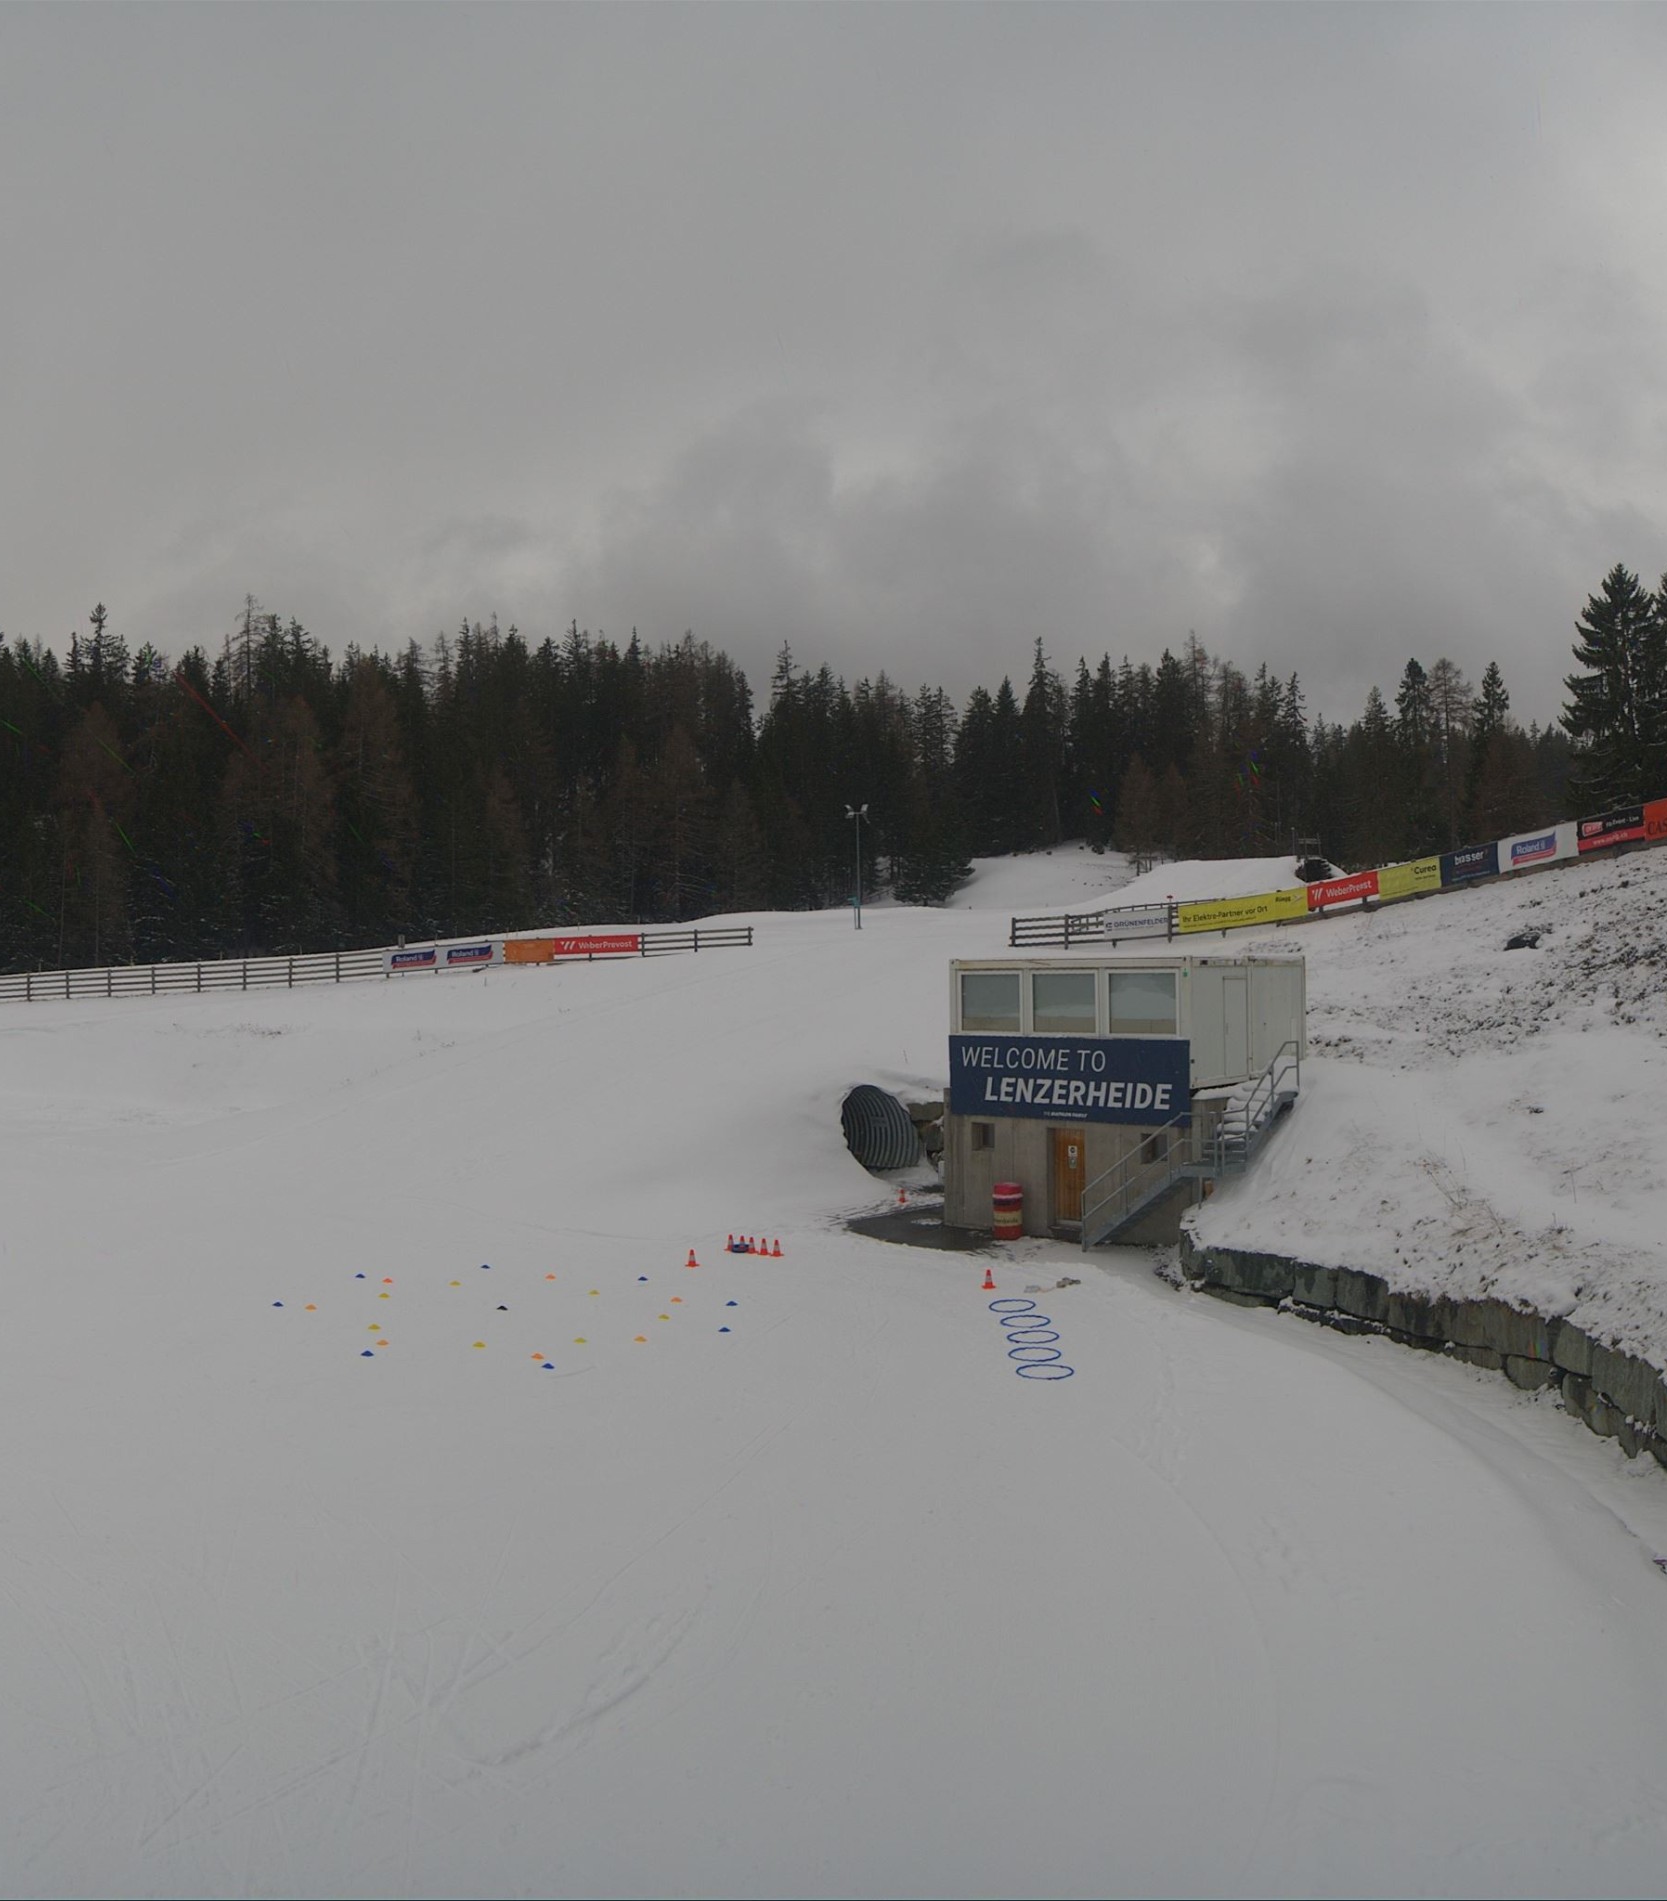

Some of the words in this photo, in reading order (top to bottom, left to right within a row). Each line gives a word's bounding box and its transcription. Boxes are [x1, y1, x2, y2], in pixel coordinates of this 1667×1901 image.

[1516, 844, 1541, 855] Roland
[1414, 865, 1436, 874] Curea
[1245, 908, 1255, 916] vor
[961, 1047, 1069, 1070] WELCOME
[1077, 1050, 1106, 1072] TO
[984, 1077, 1172, 1110] LENZERHEIDE
